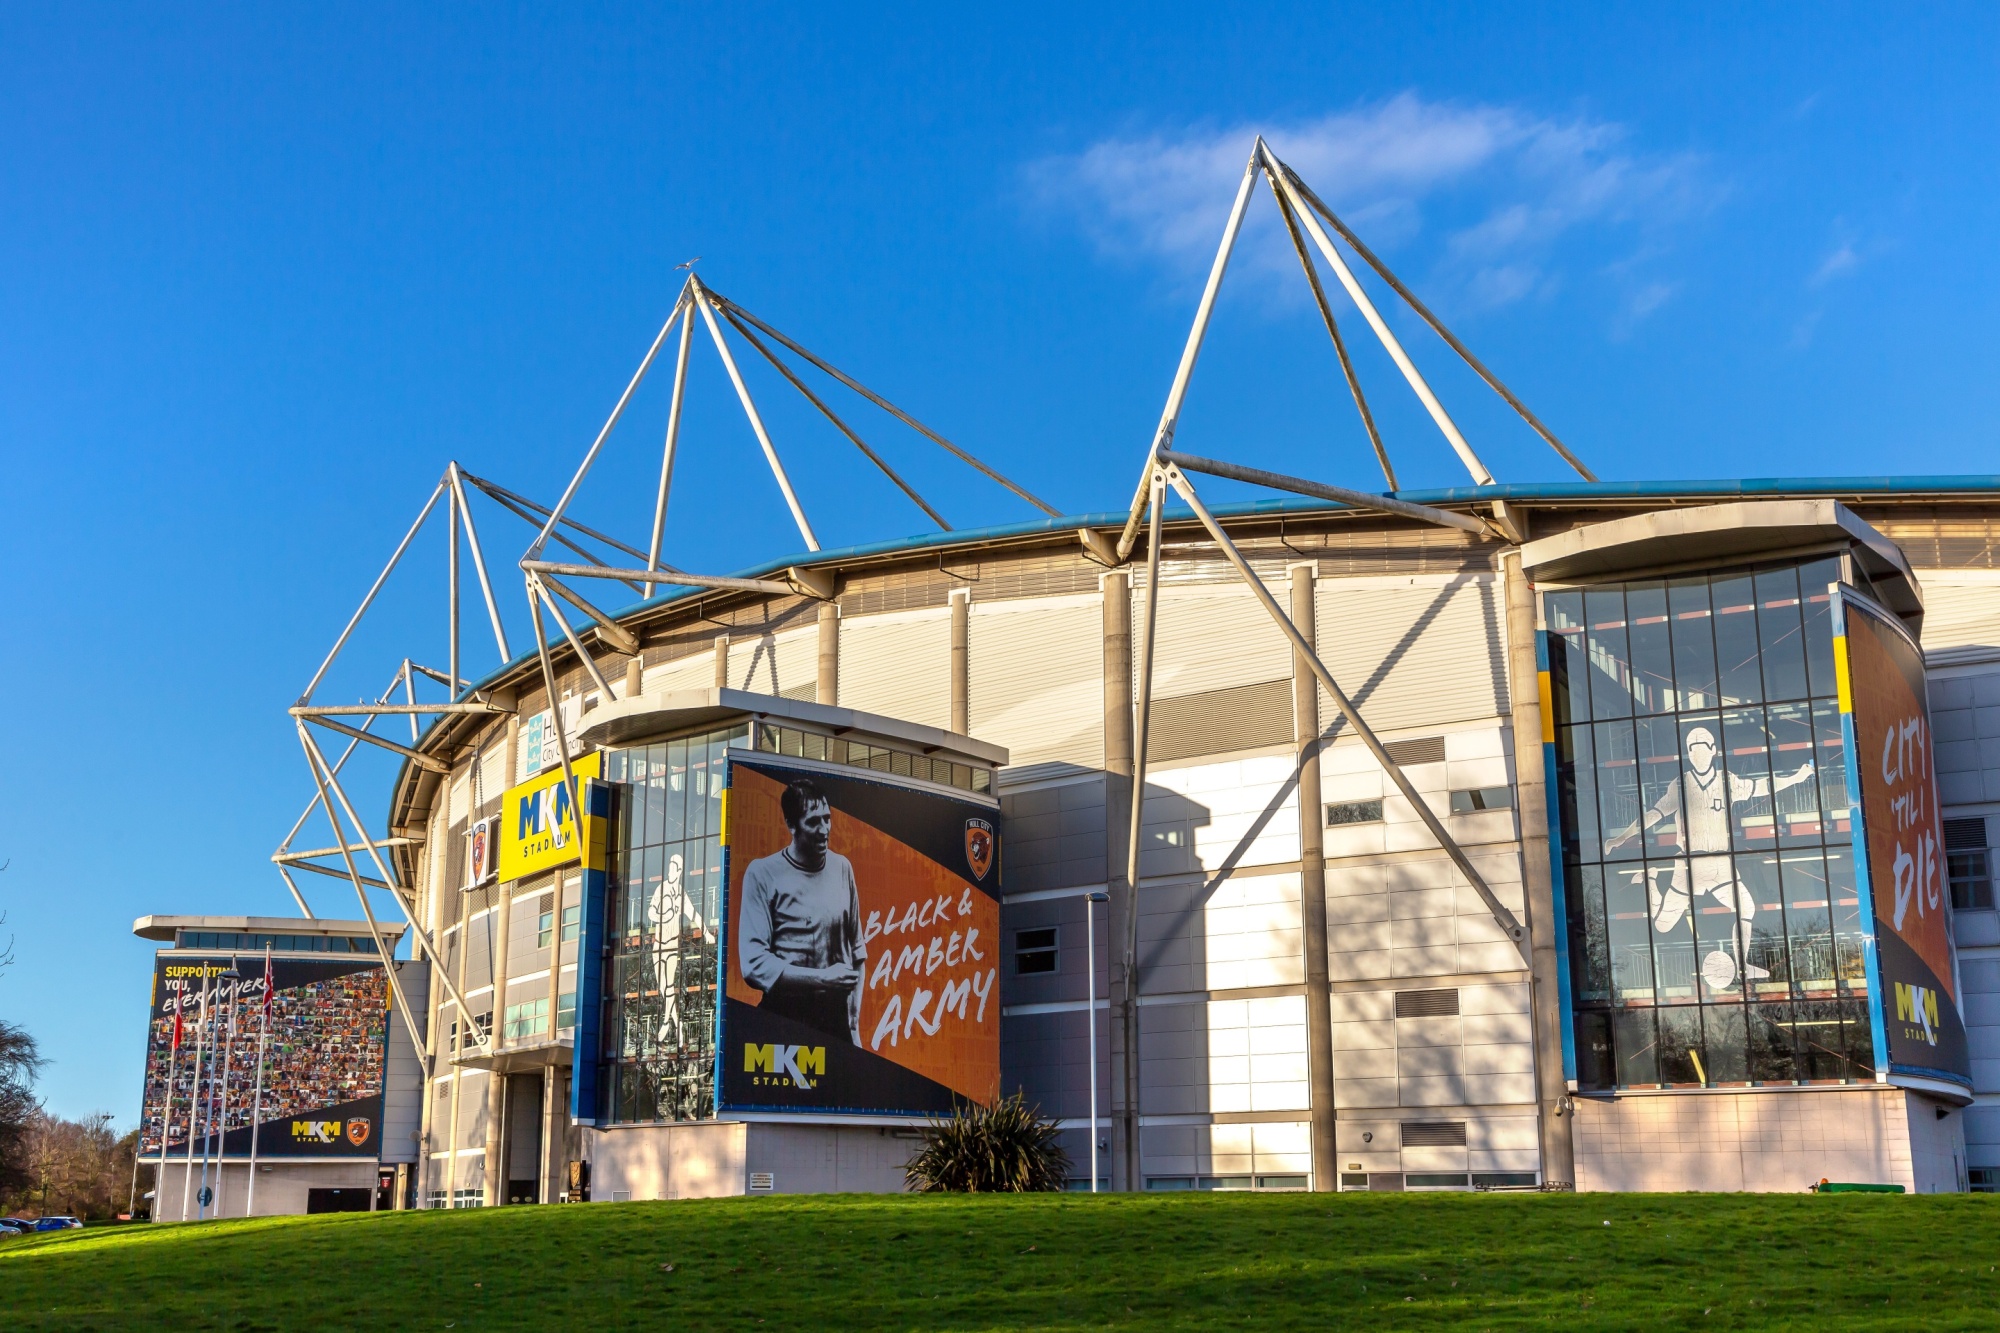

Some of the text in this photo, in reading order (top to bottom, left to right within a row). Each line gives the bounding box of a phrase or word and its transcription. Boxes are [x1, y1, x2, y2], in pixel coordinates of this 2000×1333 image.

[543, 739, 579, 762] City Cncil
[1882, 715, 1926, 786] CITY
[518, 774, 578, 850] MKM
[969, 820, 990, 832] HULL CITY
[523, 830, 571, 858] STADIUM
[1893, 828, 1938, 931] DIE
[864, 887, 973, 945] BLACK &
[165, 966, 238, 978] SUPPORTI
[869, 926, 984, 990] AMBER
[162, 975, 274, 1012] EVERWHER
[871, 968, 996, 1051] ARMY
[1894, 981, 1940, 1046] MKM
[1904, 1027, 1938, 1044] STADM
[744, 1043, 826, 1090] MKM
[753, 1077, 817, 1088] STADIUM
[291, 1121, 341, 1143] MKM
